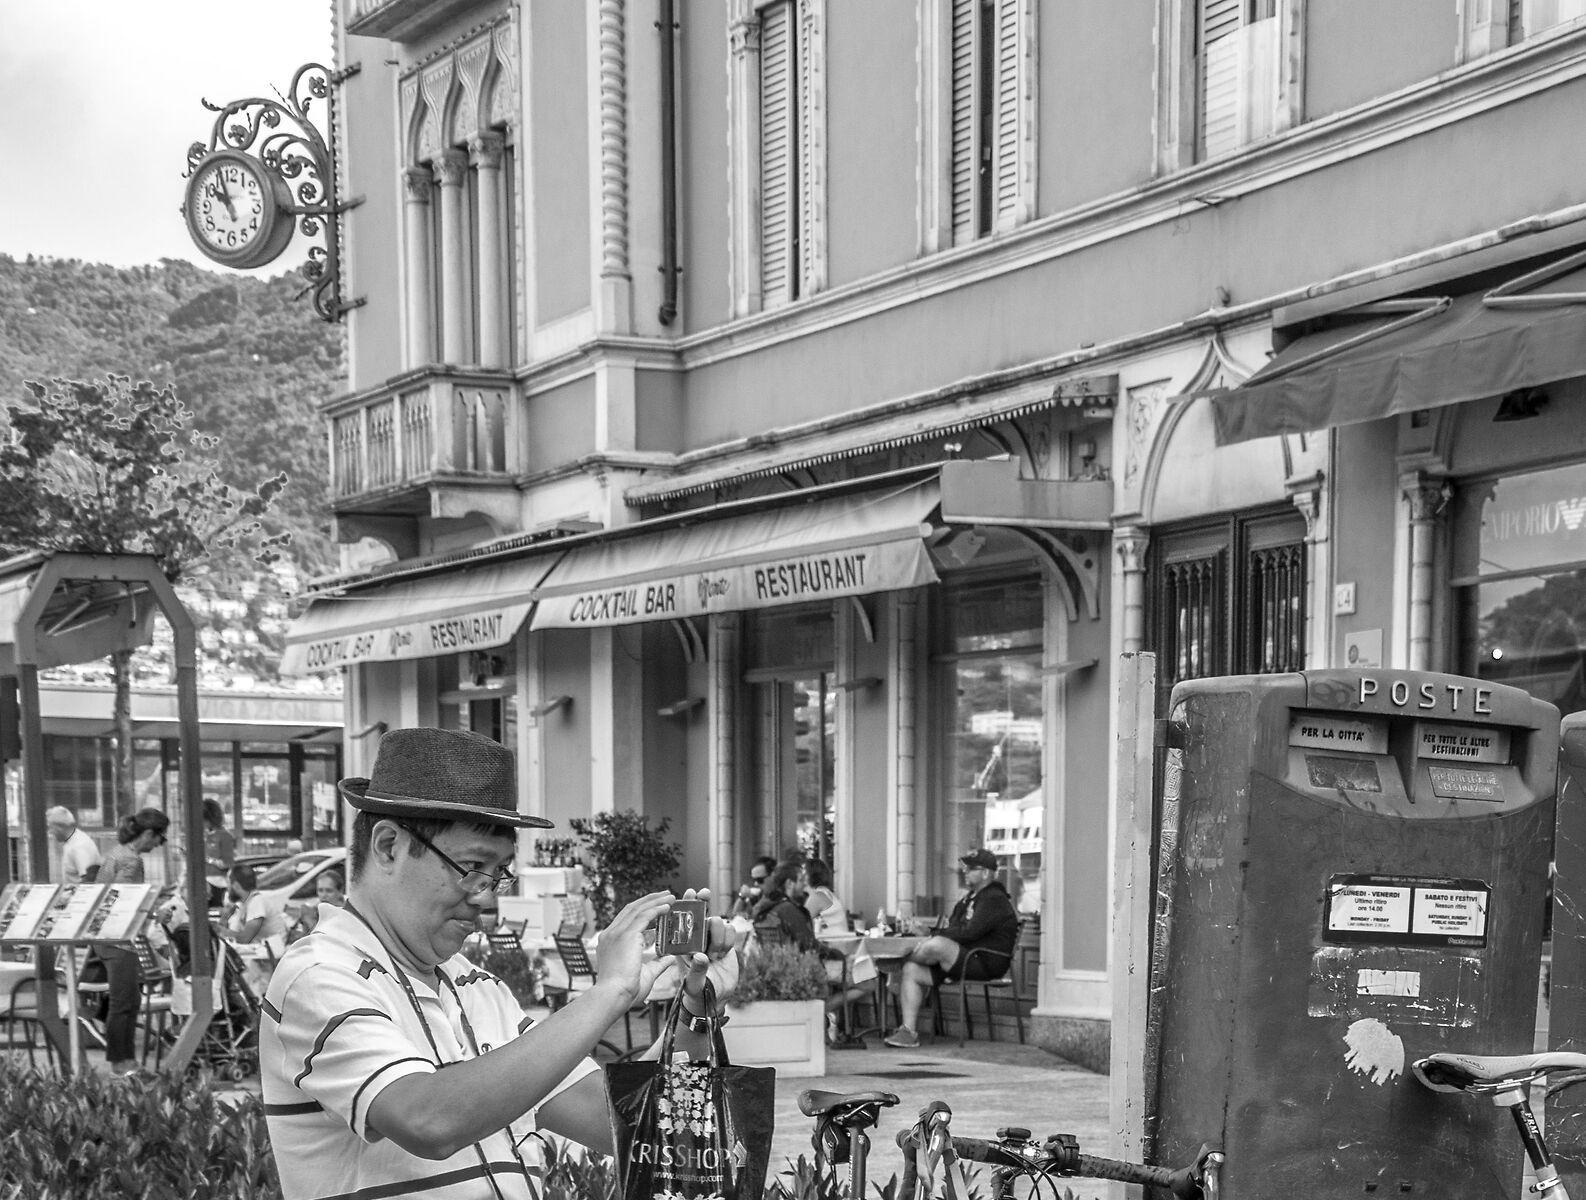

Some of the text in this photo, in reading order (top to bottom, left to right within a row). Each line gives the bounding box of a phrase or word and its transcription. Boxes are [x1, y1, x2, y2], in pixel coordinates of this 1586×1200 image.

[225, 168, 238, 183] 12
[204, 183, 216, 198] 10
[248, 180, 257, 196] 2
[203, 200, 212, 215] 9
[252, 198, 262, 215] 3
[205, 216, 216, 231] 8
[249, 217, 258, 231] 4
[227, 230, 237, 247] 6
[240, 228, 248, 243] 5
[568, 588, 638, 622] COCKTAIL
[644, 583, 676, 615] BAR
[754, 555, 867, 600] RESTAURANT
[306, 639, 349, 668] COCKTAIL
[351, 634, 375, 658] BAR
[430, 614, 503, 649] RESTAURANT
[1360, 677, 1493, 714] POSTE
[1301, 726, 1319, 738] PER
[1322, 728, 1334, 739] LA
[1423, 734, 1491, 748] PER TUTTE LE ALTRE
[1431, 744, 1480, 757] DESTINAZIONI
[1524, 1112, 1539, 1134] FRM
